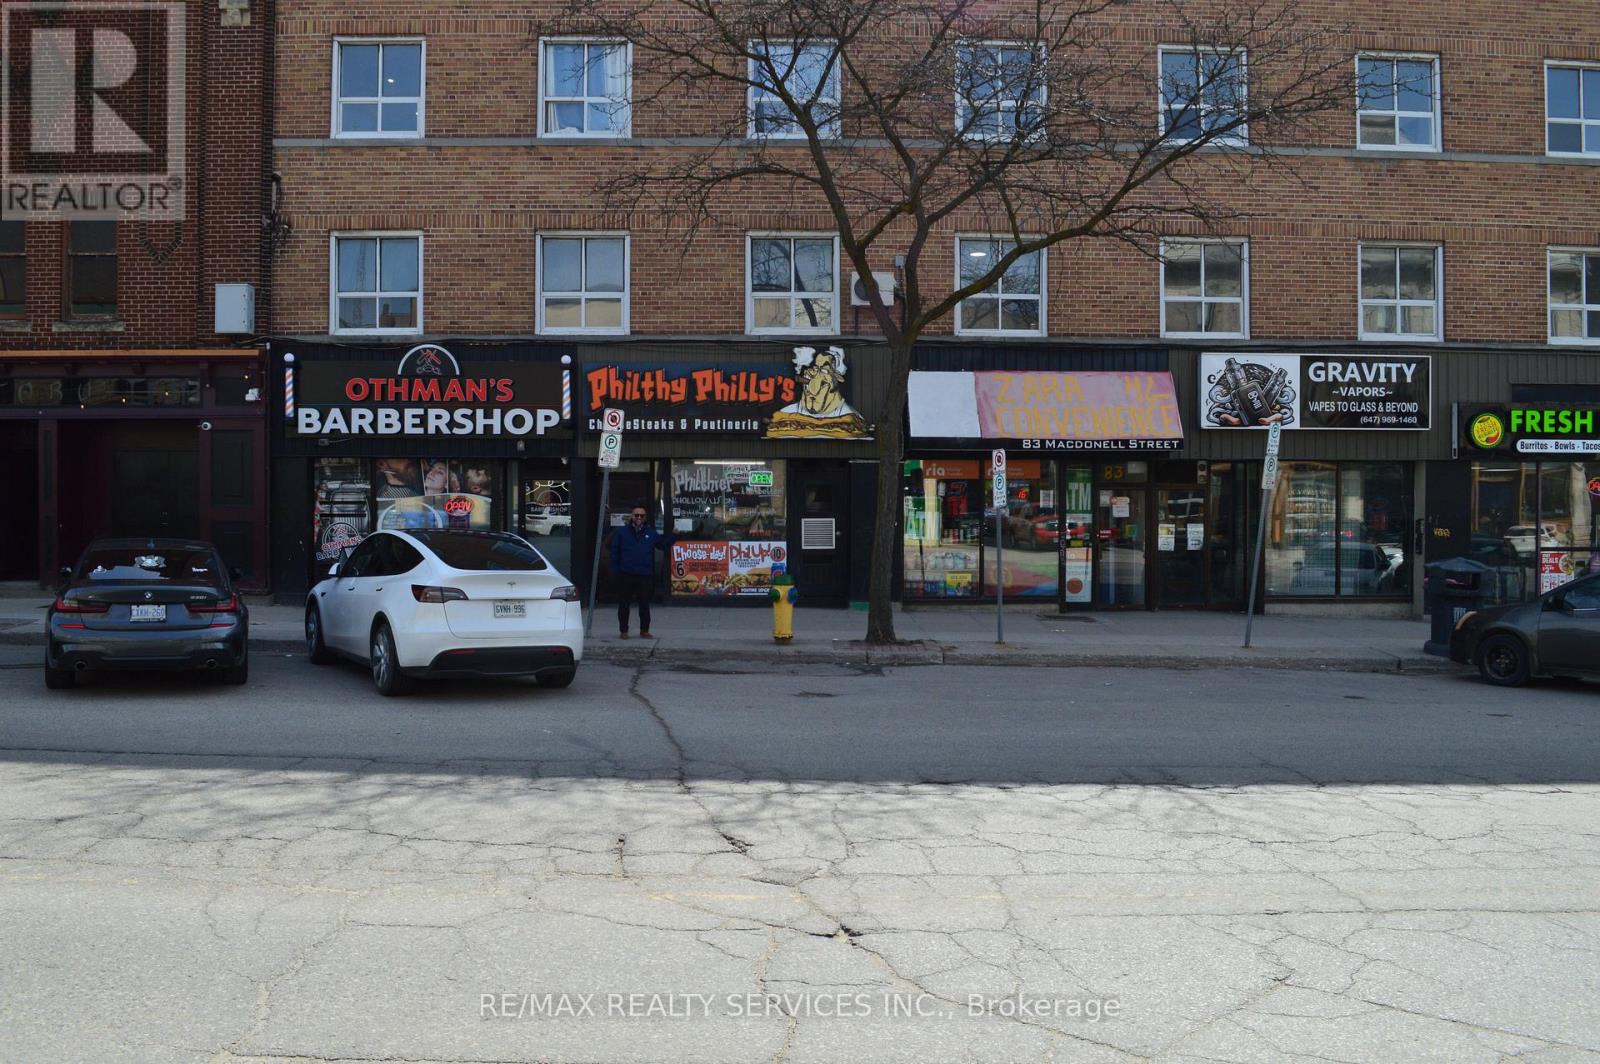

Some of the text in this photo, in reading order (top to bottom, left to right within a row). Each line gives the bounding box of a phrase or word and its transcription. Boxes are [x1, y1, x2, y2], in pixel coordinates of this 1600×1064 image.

[1308, 361, 1417, 384] GRAVITY
[344, 377, 515, 403] OTHMAN'S
[587, 364, 796, 411] Philthy Philly's
[1308, 401, 1419, 413] VAPES TO GLASS & BEYOND
[297, 407, 560, 436] BARBERSHOP
[588, 418, 759, 431] CheSteaks & Poutinerie
[993, 404, 1181, 438] CONVENIENCE
[1360, 415, 1380, 425] (647)
[1510, 409, 1593, 434] FRESH
[1022, 438, 1180, 450] 83 MACDONELL STREET
[1519, 441, 1549, 451] Burritos
[1554, 441, 1576, 451] Bowls
[926, 463, 946, 477] ria
[1104, 464, 1124, 480] 83
[750, 473, 772, 485] OPEN
[446, 500, 473, 512] OPEN
[675, 562, 685, 576] 6
